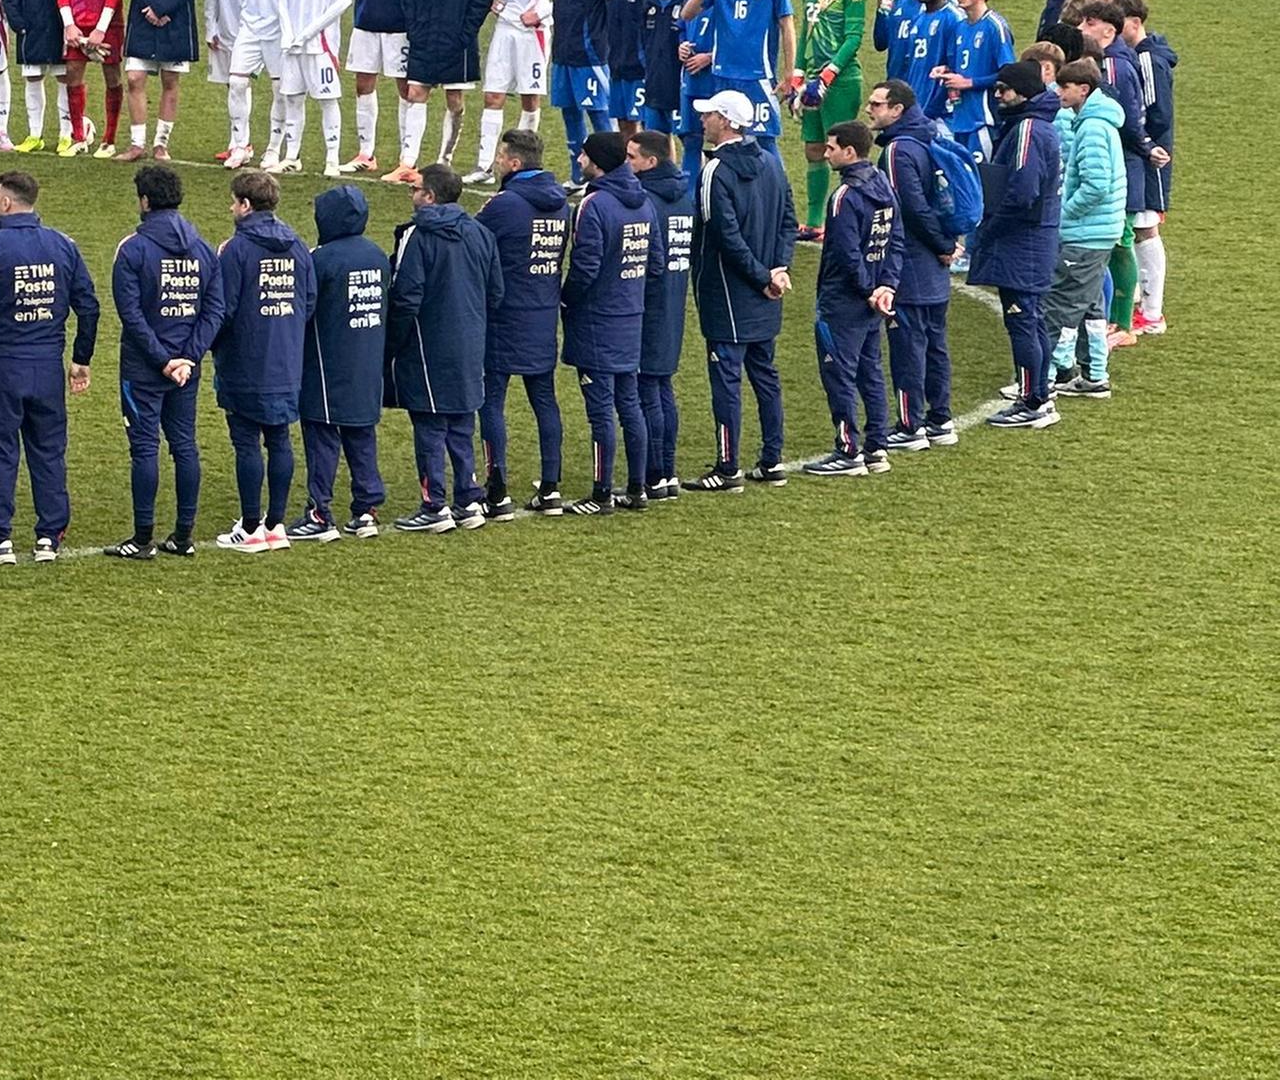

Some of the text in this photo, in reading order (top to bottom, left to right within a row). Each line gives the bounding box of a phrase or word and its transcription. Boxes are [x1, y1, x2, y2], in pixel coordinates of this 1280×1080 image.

[734, 0, 747, 19] 16
[700, 17, 709, 36] 7
[960, 49, 969, 69] 3
[321, 67, 333, 84] 10
[532, 62, 541, 79] 6
[587, 77, 597, 96] 4
[634, 88, 646, 107] 5
[755, 103, 770, 122] 16
[29, 264, 54, 278] TIM
[174, 259, 199, 273] TIM
[273, 259, 295, 272] TIM
[160, 274, 200, 287] Poste
[259, 274, 295, 287] Poste
[360, 269, 381, 283] TIM
[14, 280, 55, 293] Poste
[348, 285, 382, 299] Poste
[14, 308, 37, 321] eni
[160, 303, 182, 316] eni
[260, 303, 280, 316] eni
